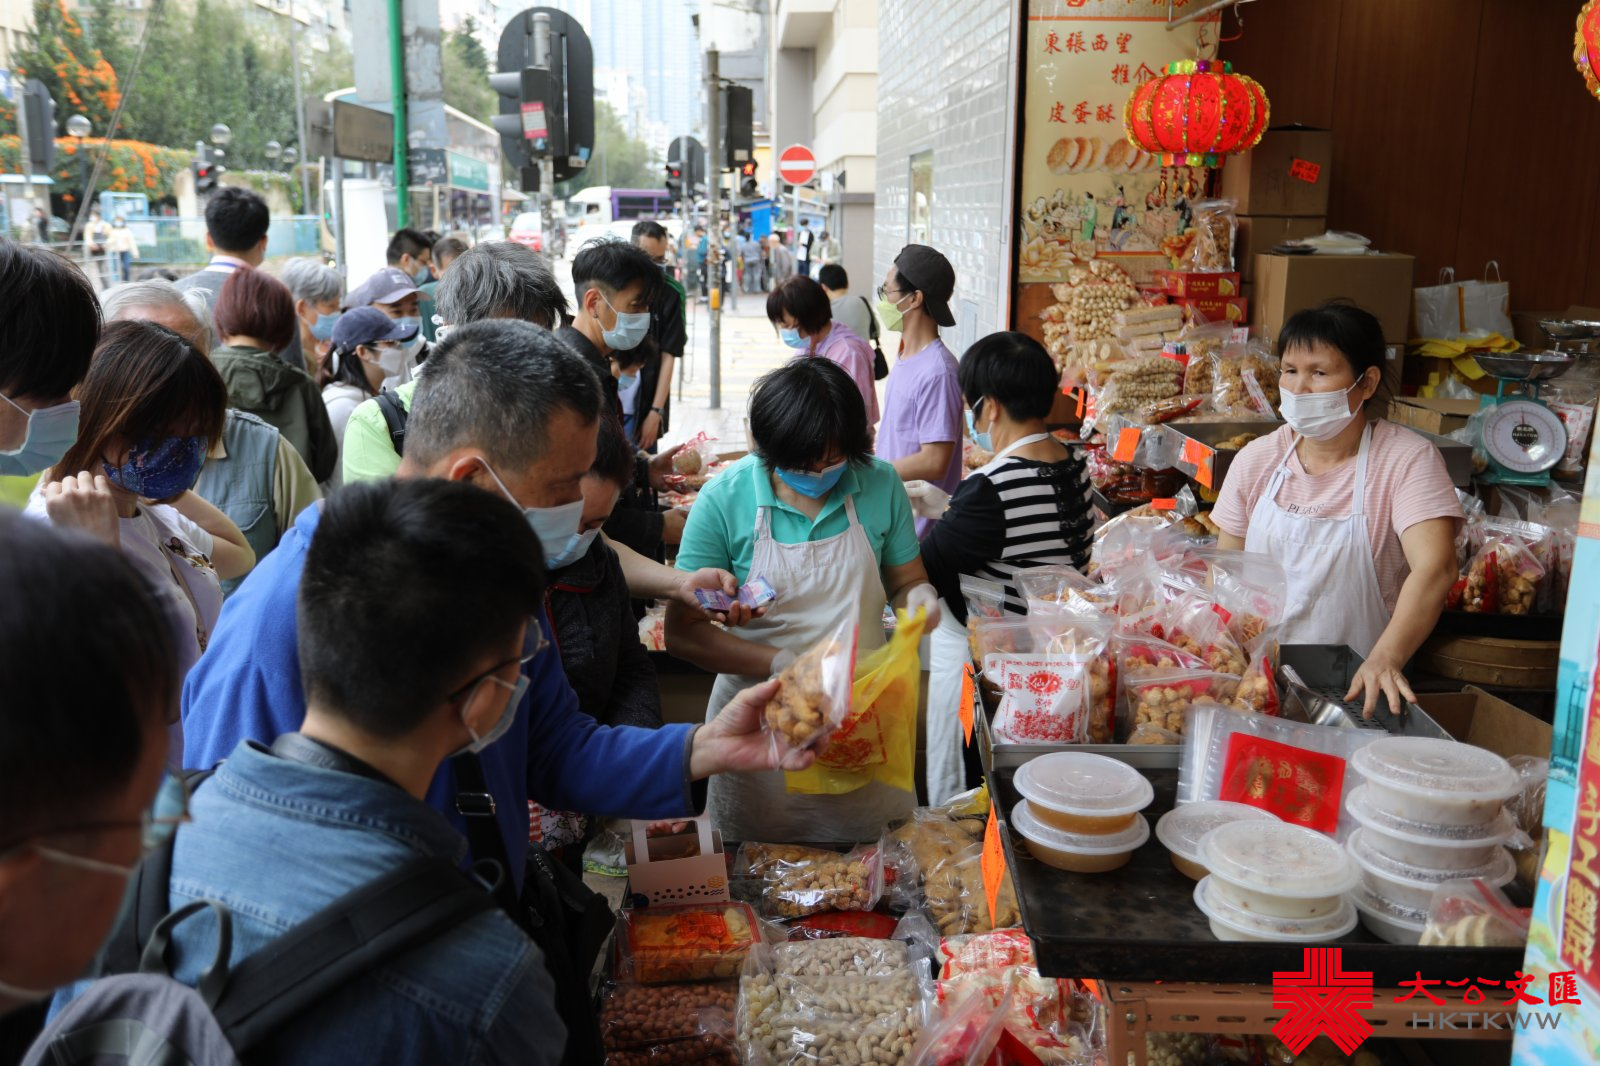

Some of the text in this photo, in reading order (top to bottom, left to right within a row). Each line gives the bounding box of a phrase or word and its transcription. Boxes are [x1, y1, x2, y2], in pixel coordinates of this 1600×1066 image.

[1044, 31, 1132, 54] 東張西望
[1048, 101, 1116, 124] 皮蛋酥
